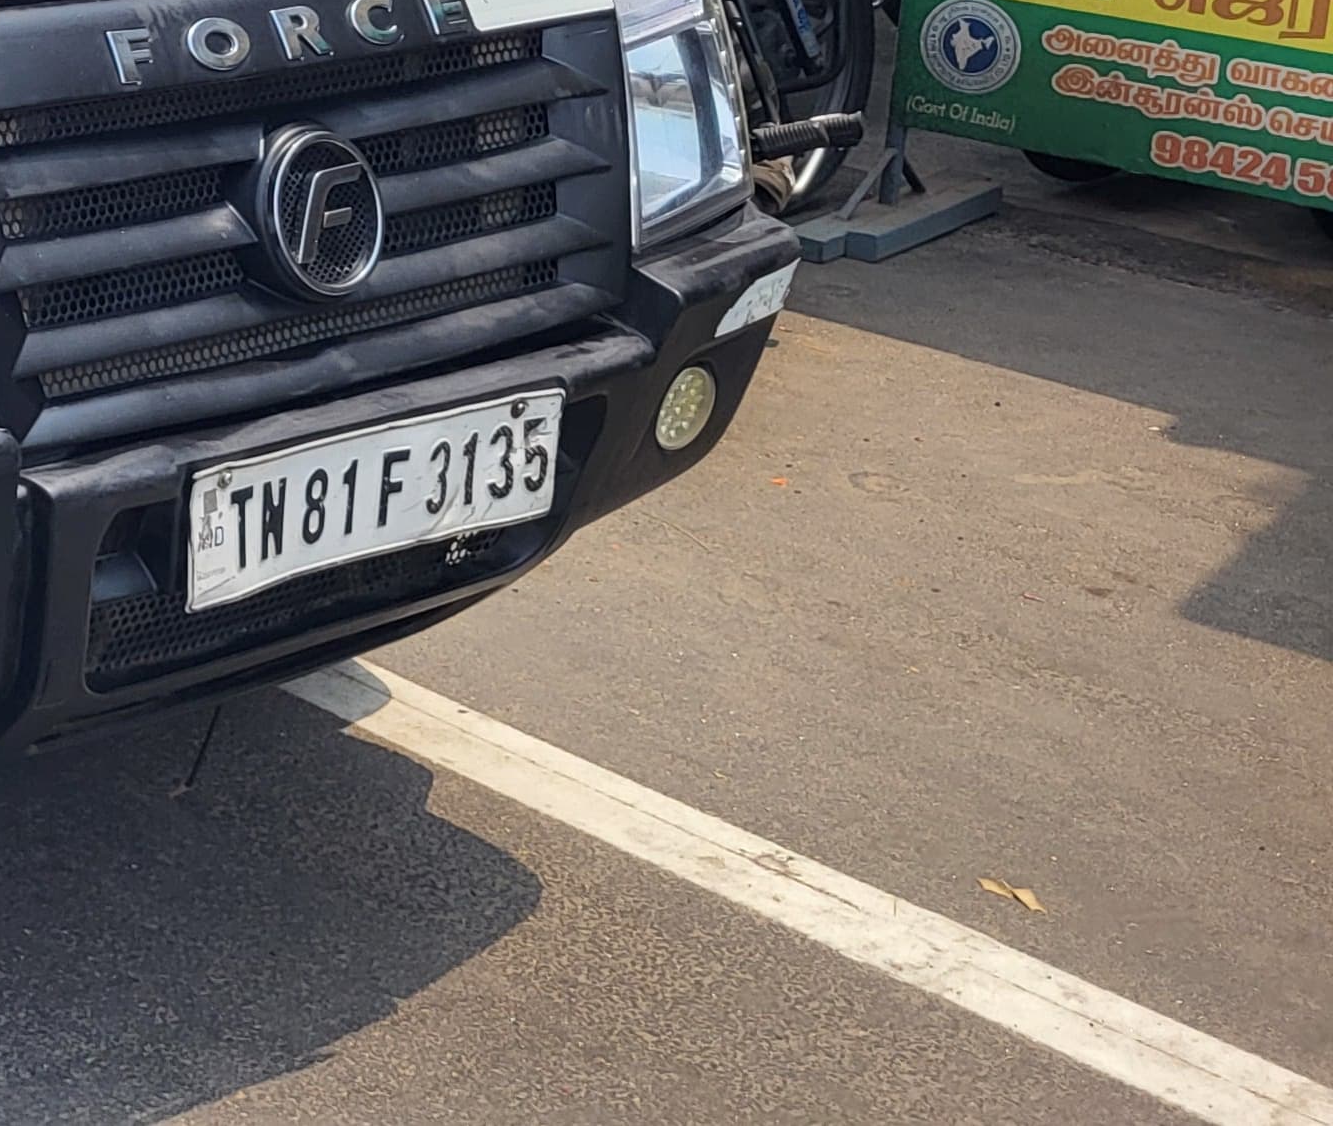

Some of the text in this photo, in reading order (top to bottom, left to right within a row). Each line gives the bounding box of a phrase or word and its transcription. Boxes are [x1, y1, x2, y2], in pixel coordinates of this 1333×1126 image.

[1042, 25, 1220, 87] அனைத்து
[949, 103, 968, 123] Of
[970, 107, 1016, 134] India)
[1052, 64, 1265, 130] இன்சூரன்ஸ்
[1150, 131, 1292, 190] 98424
[425, 416, 549, 515] 3135
